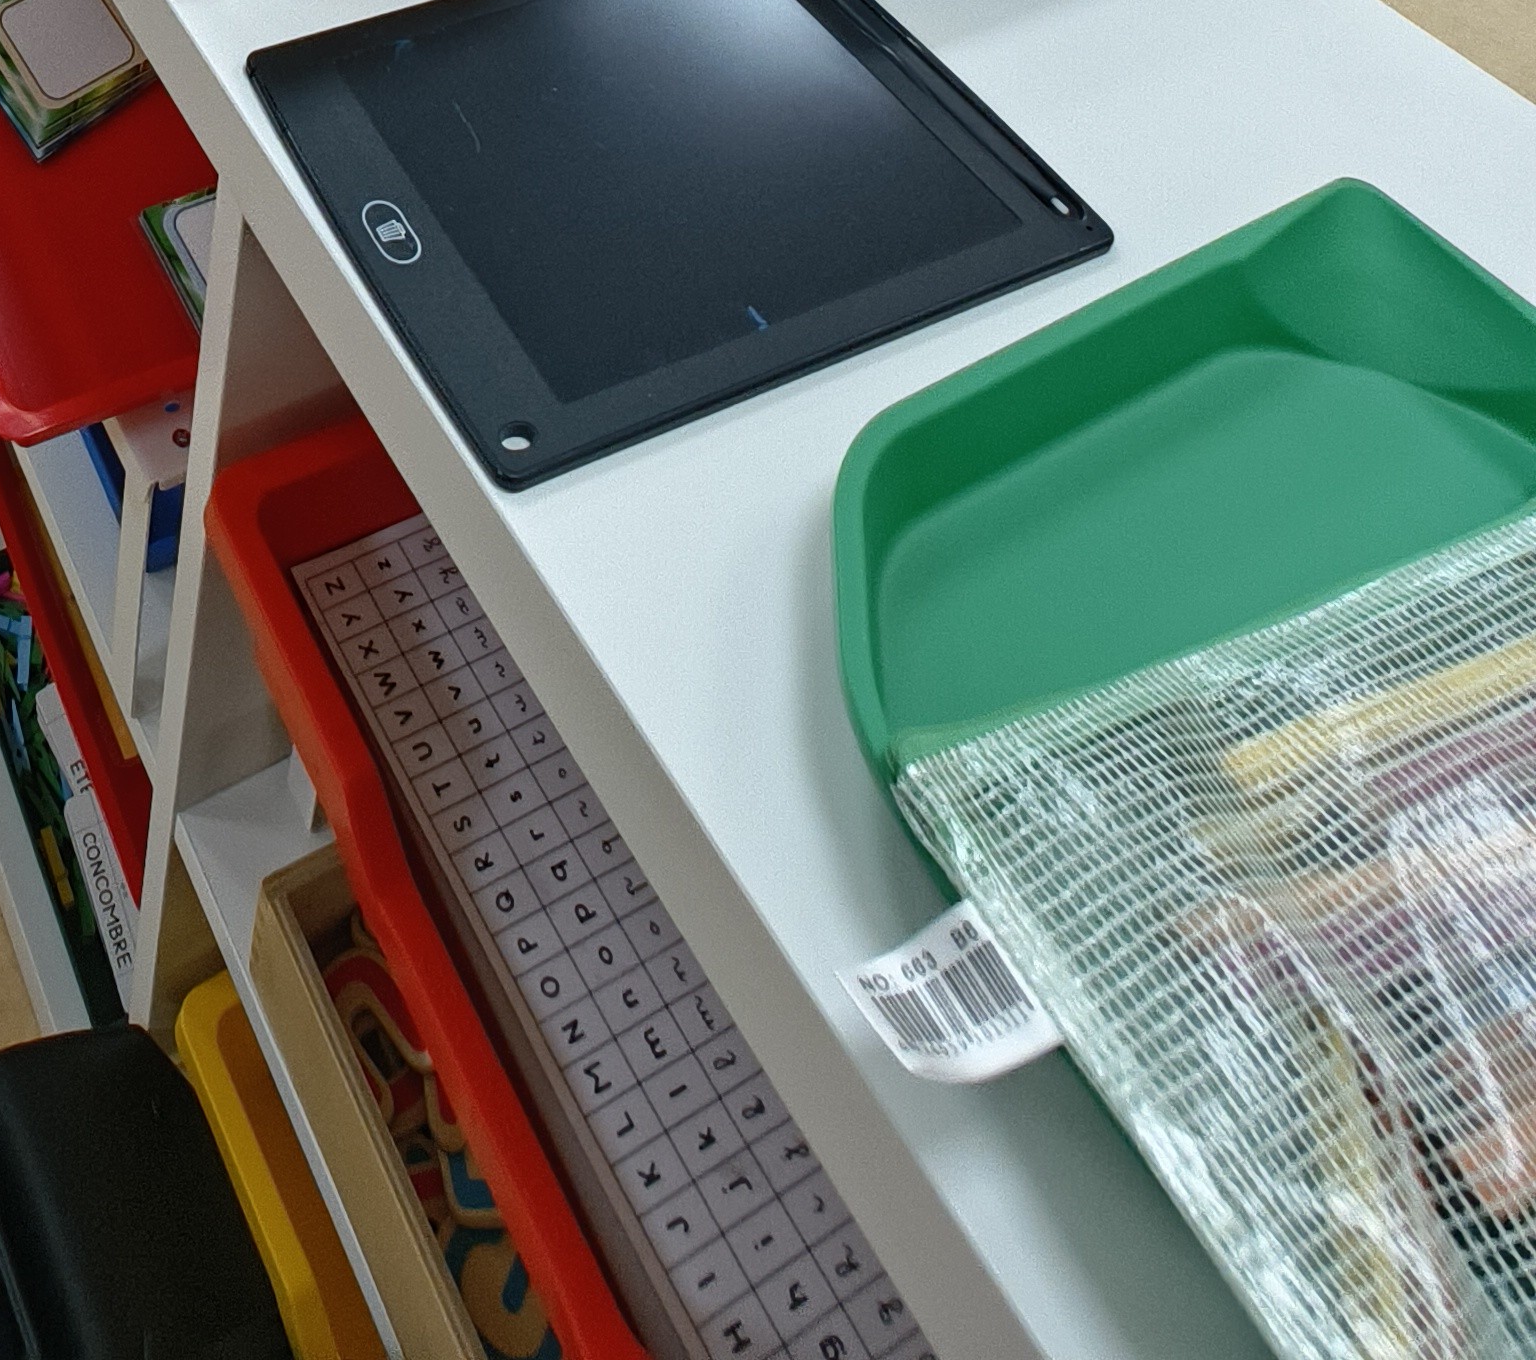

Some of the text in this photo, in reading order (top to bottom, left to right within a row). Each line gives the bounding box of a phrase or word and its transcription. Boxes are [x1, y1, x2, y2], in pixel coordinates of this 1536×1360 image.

[484, 752, 500, 769] t
[431, 781, 451, 798] T
[529, 829, 545, 842] r
[474, 852, 495, 872] R
[550, 859, 568, 882] q
[82, 832, 133, 969] CONCOMBRE
[495, 889, 515, 913] Q
[574, 903, 597, 925] p
[517, 937, 539, 955] P
[622, 988, 640, 1009] n
[561, 1018, 585, 1045] N
[643, 1026, 668, 1060] m
[583, 1061, 612, 1095] M
[616, 1111, 635, 1138] L
[666, 1216, 690, 1234] J
[789, 1281, 809, 1311] h
[723, 1320, 751, 1354] H
